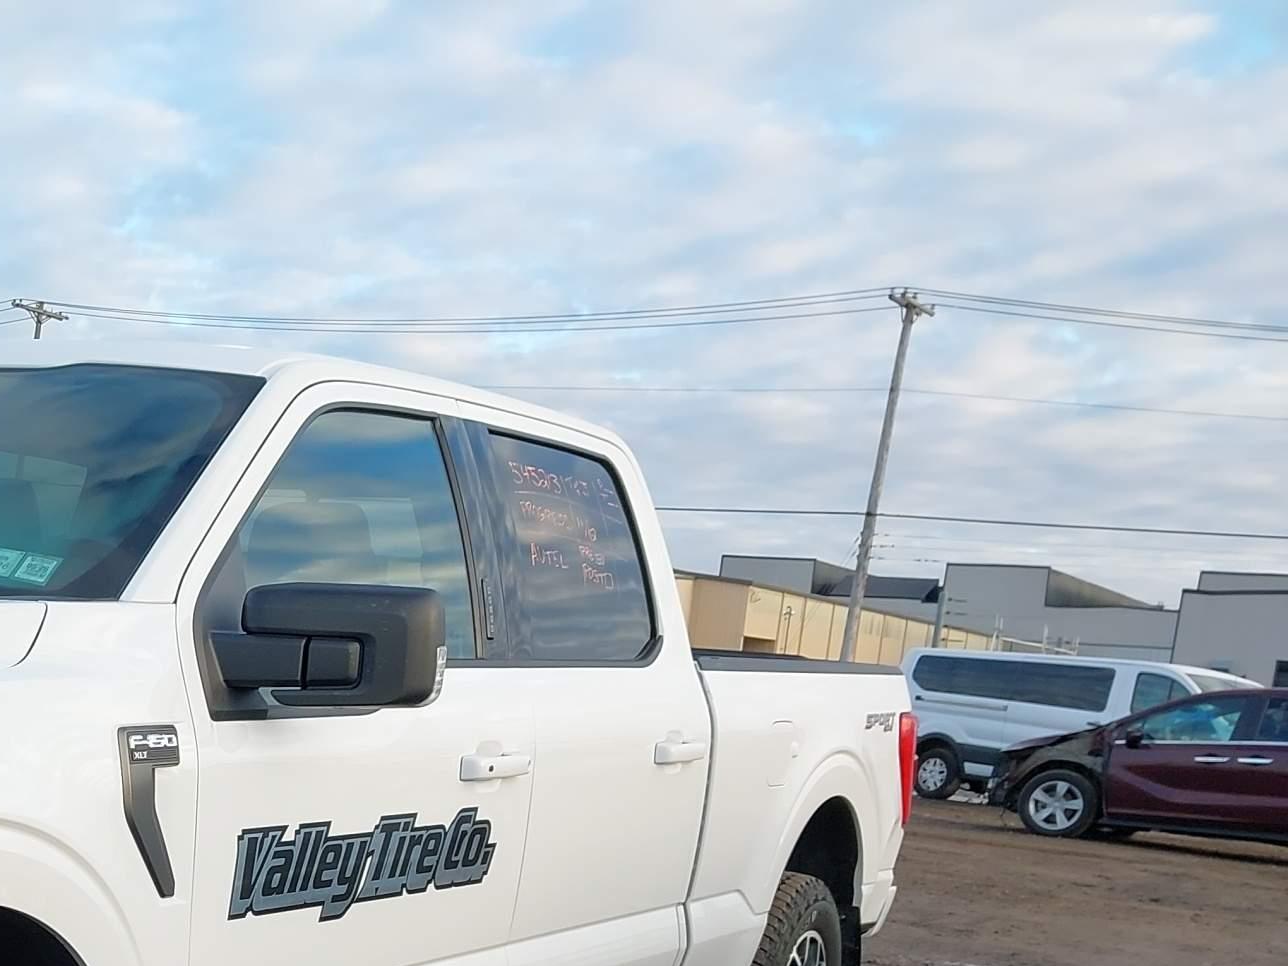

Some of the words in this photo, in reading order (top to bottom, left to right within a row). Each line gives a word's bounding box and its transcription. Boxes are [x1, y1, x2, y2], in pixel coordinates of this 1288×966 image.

[133, 751, 148, 760] XLT
[229, 822, 370, 921] Valley
[364, 813, 445, 896] Tire
[436, 807, 495, 886] Co.
